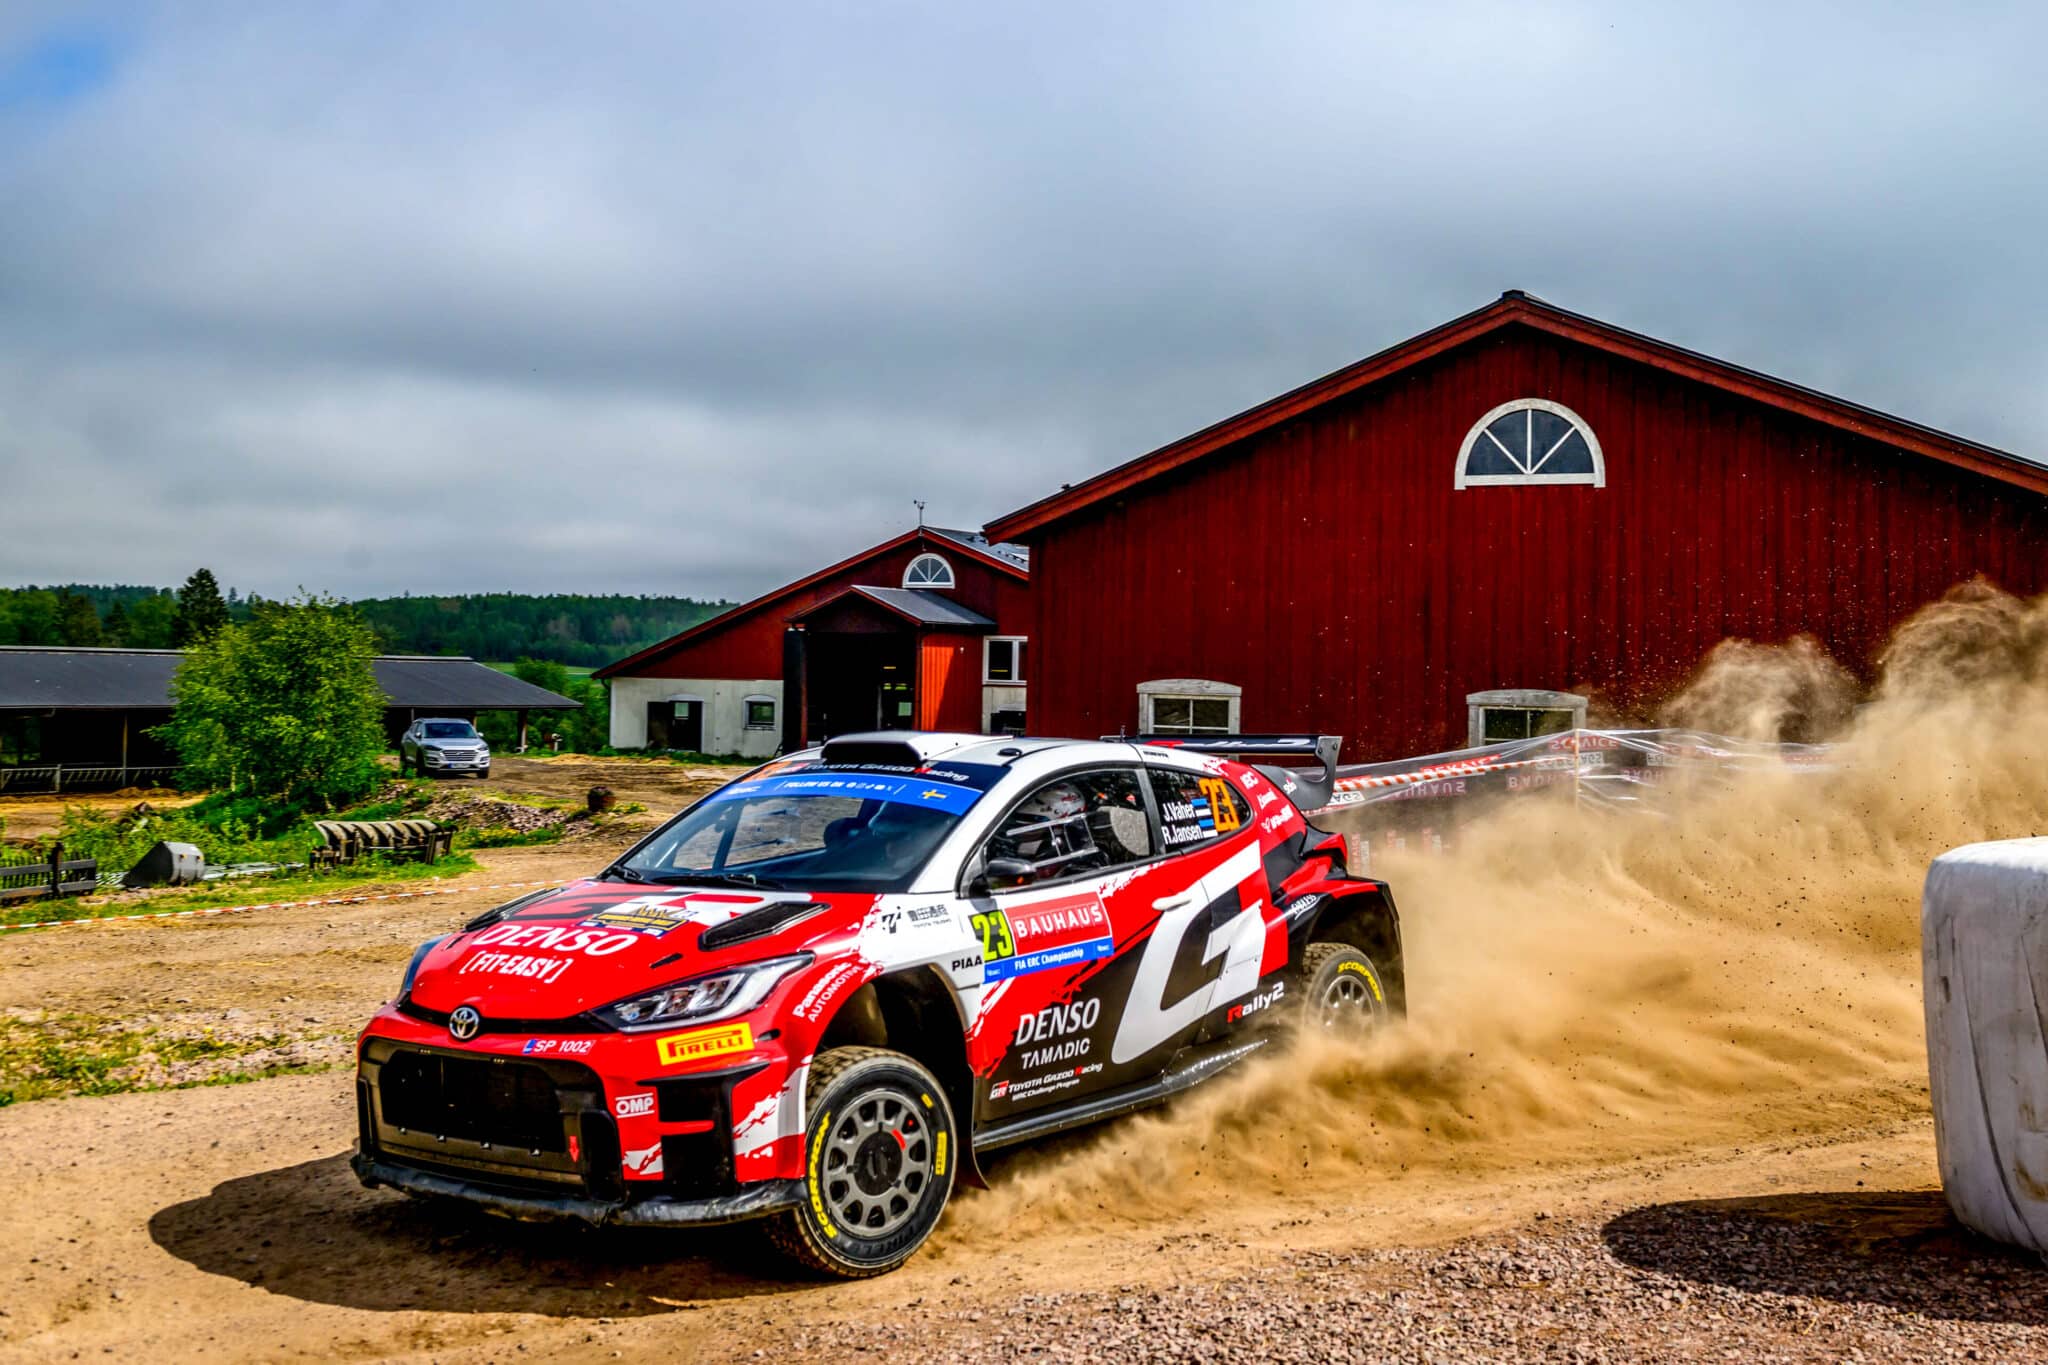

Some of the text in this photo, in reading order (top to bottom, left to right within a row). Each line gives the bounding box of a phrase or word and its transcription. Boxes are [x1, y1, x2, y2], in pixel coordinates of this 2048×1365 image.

[914, 766, 970, 782] Racing
[1163, 801, 1196, 822] J.Vaher
[1197, 777, 1240, 832] 23
[1161, 823, 1204, 845] R.Jansen
[1014, 902, 1103, 938] BAUHAUS
[472, 924, 639, 956] DENSO
[972, 911, 1014, 962] 23
[952, 955, 982, 971] PIAA
[1015, 960, 1027, 970] FIA
[1027, 957, 1040, 968] ERC
[1041, 947, 1084, 965] Championship
[793, 961, 852, 1019] Panasonic
[808, 965, 864, 1023] AUTOMOTIV
[1227, 981, 1285, 1023] Rally2
[1015, 998, 1100, 1047] DENSO
[534, 1040, 591, 1054] SP 1002
[668, 1030, 744, 1058] PIRELLI
[1021, 1037, 1090, 1070] TAMADIC
[1008, 1078, 1042, 1093] TOYOTA
[1043, 1069, 1074, 1084] GAZOO
[1074, 1062, 1104, 1076] Racing
[1027, 1084, 1056, 1097] Challenge
[1056, 1079, 1080, 1089] Program
[615, 1097, 655, 1116] OMP
[808, 1110, 837, 1240] SCORPION
